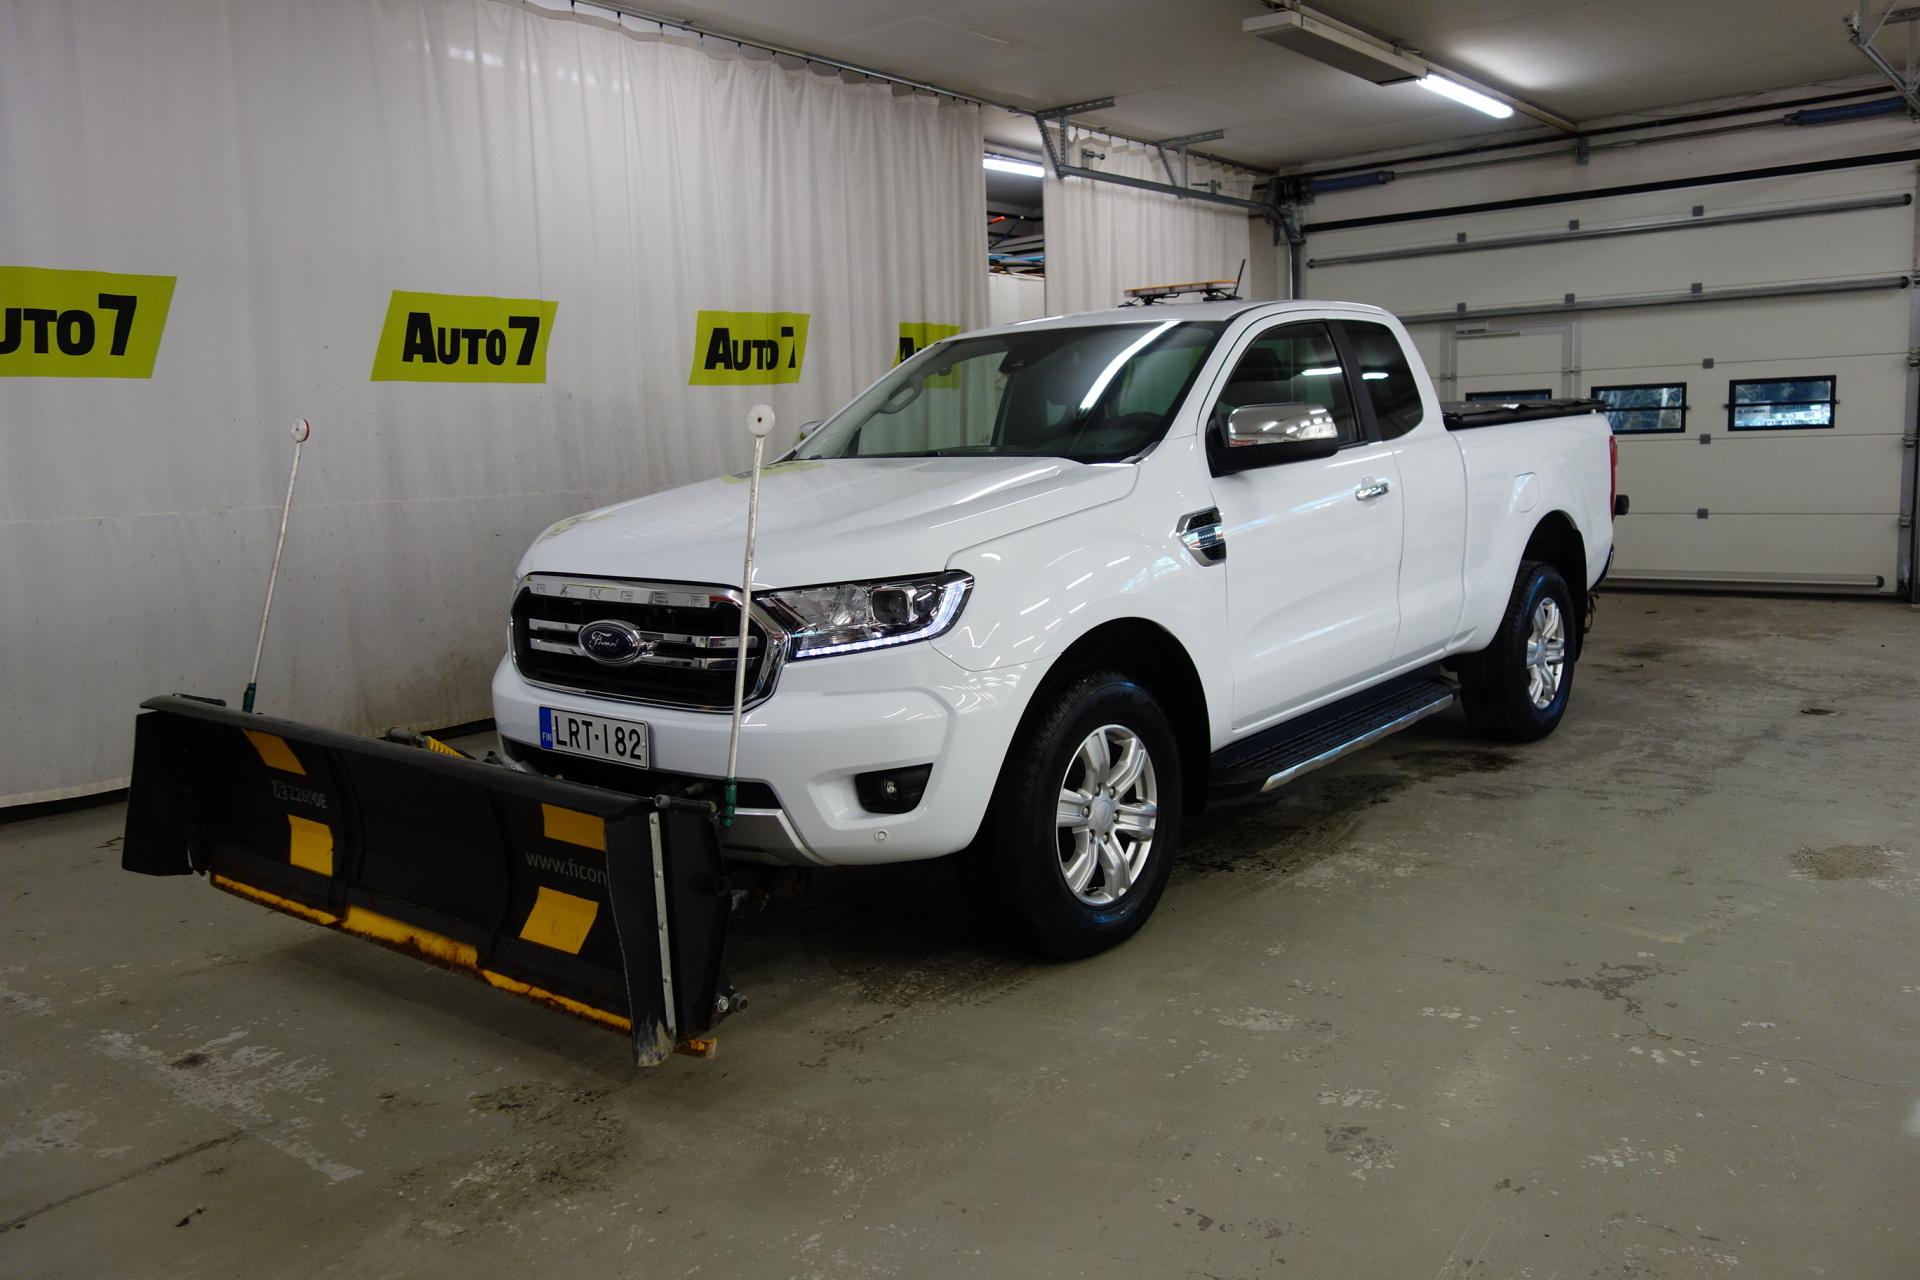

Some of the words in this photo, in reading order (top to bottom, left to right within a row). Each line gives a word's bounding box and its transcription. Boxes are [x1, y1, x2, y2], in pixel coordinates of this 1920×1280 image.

[0, 293, 138, 357] UTO7
[402, 312, 540, 366] AUTO7
[588, 630, 620, 649] Ford
[542, 731, 552, 741] FIN
[554, 715, 642, 760] LRT-182
